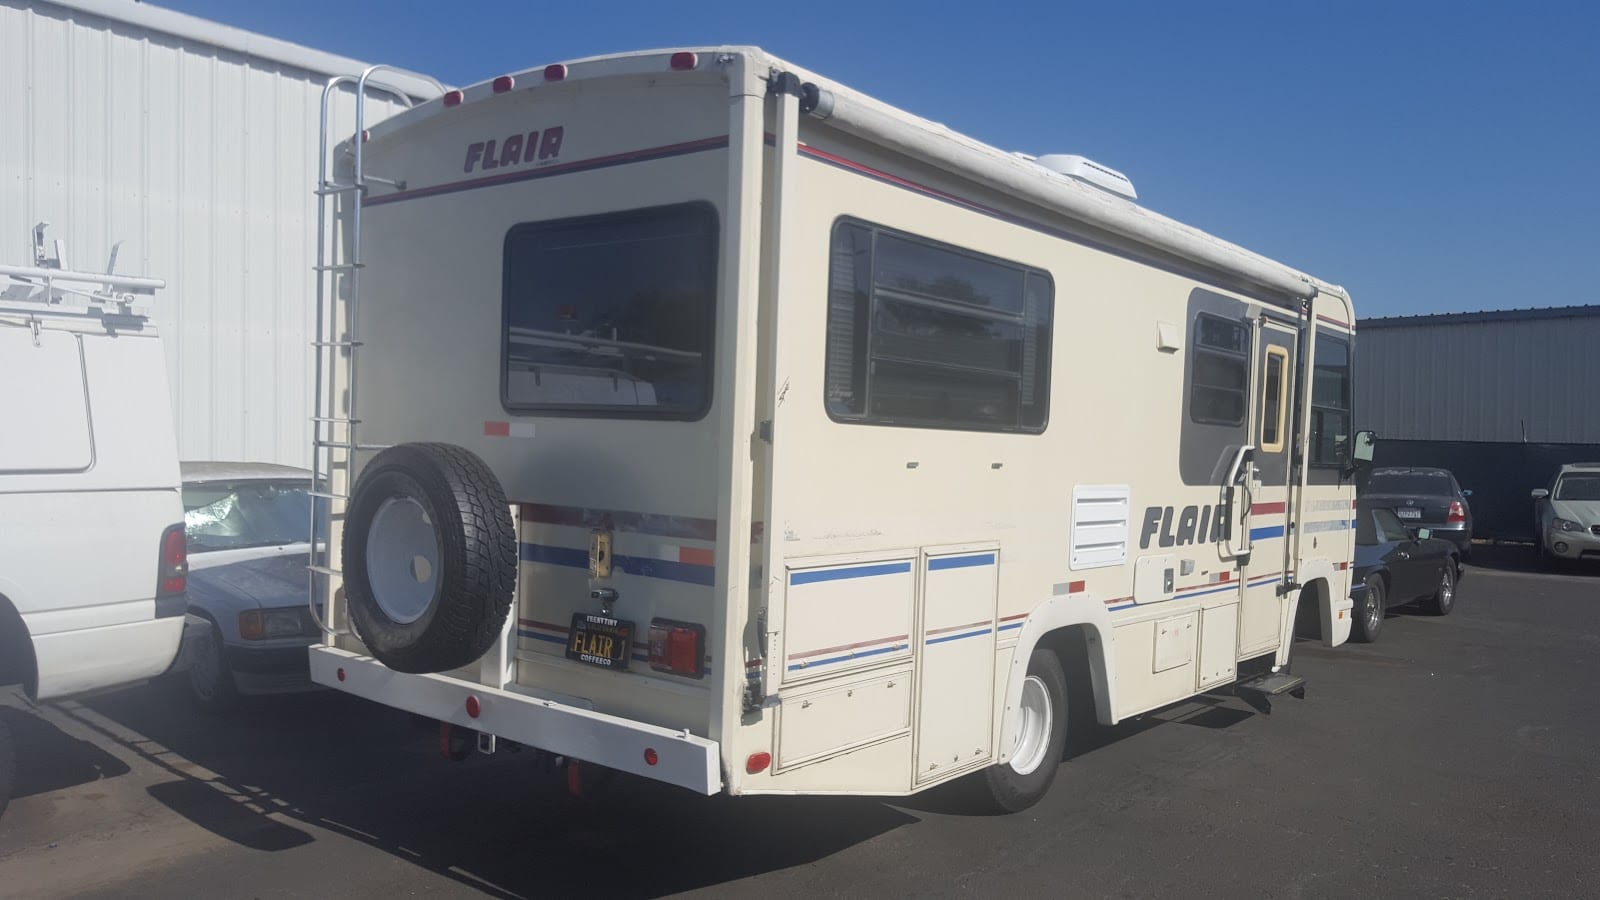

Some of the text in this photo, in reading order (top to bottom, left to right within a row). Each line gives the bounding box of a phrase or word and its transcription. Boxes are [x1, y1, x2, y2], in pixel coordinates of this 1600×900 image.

[464, 126, 564, 173] FLAIR
[574, 631, 626, 660] FLAIR 1
